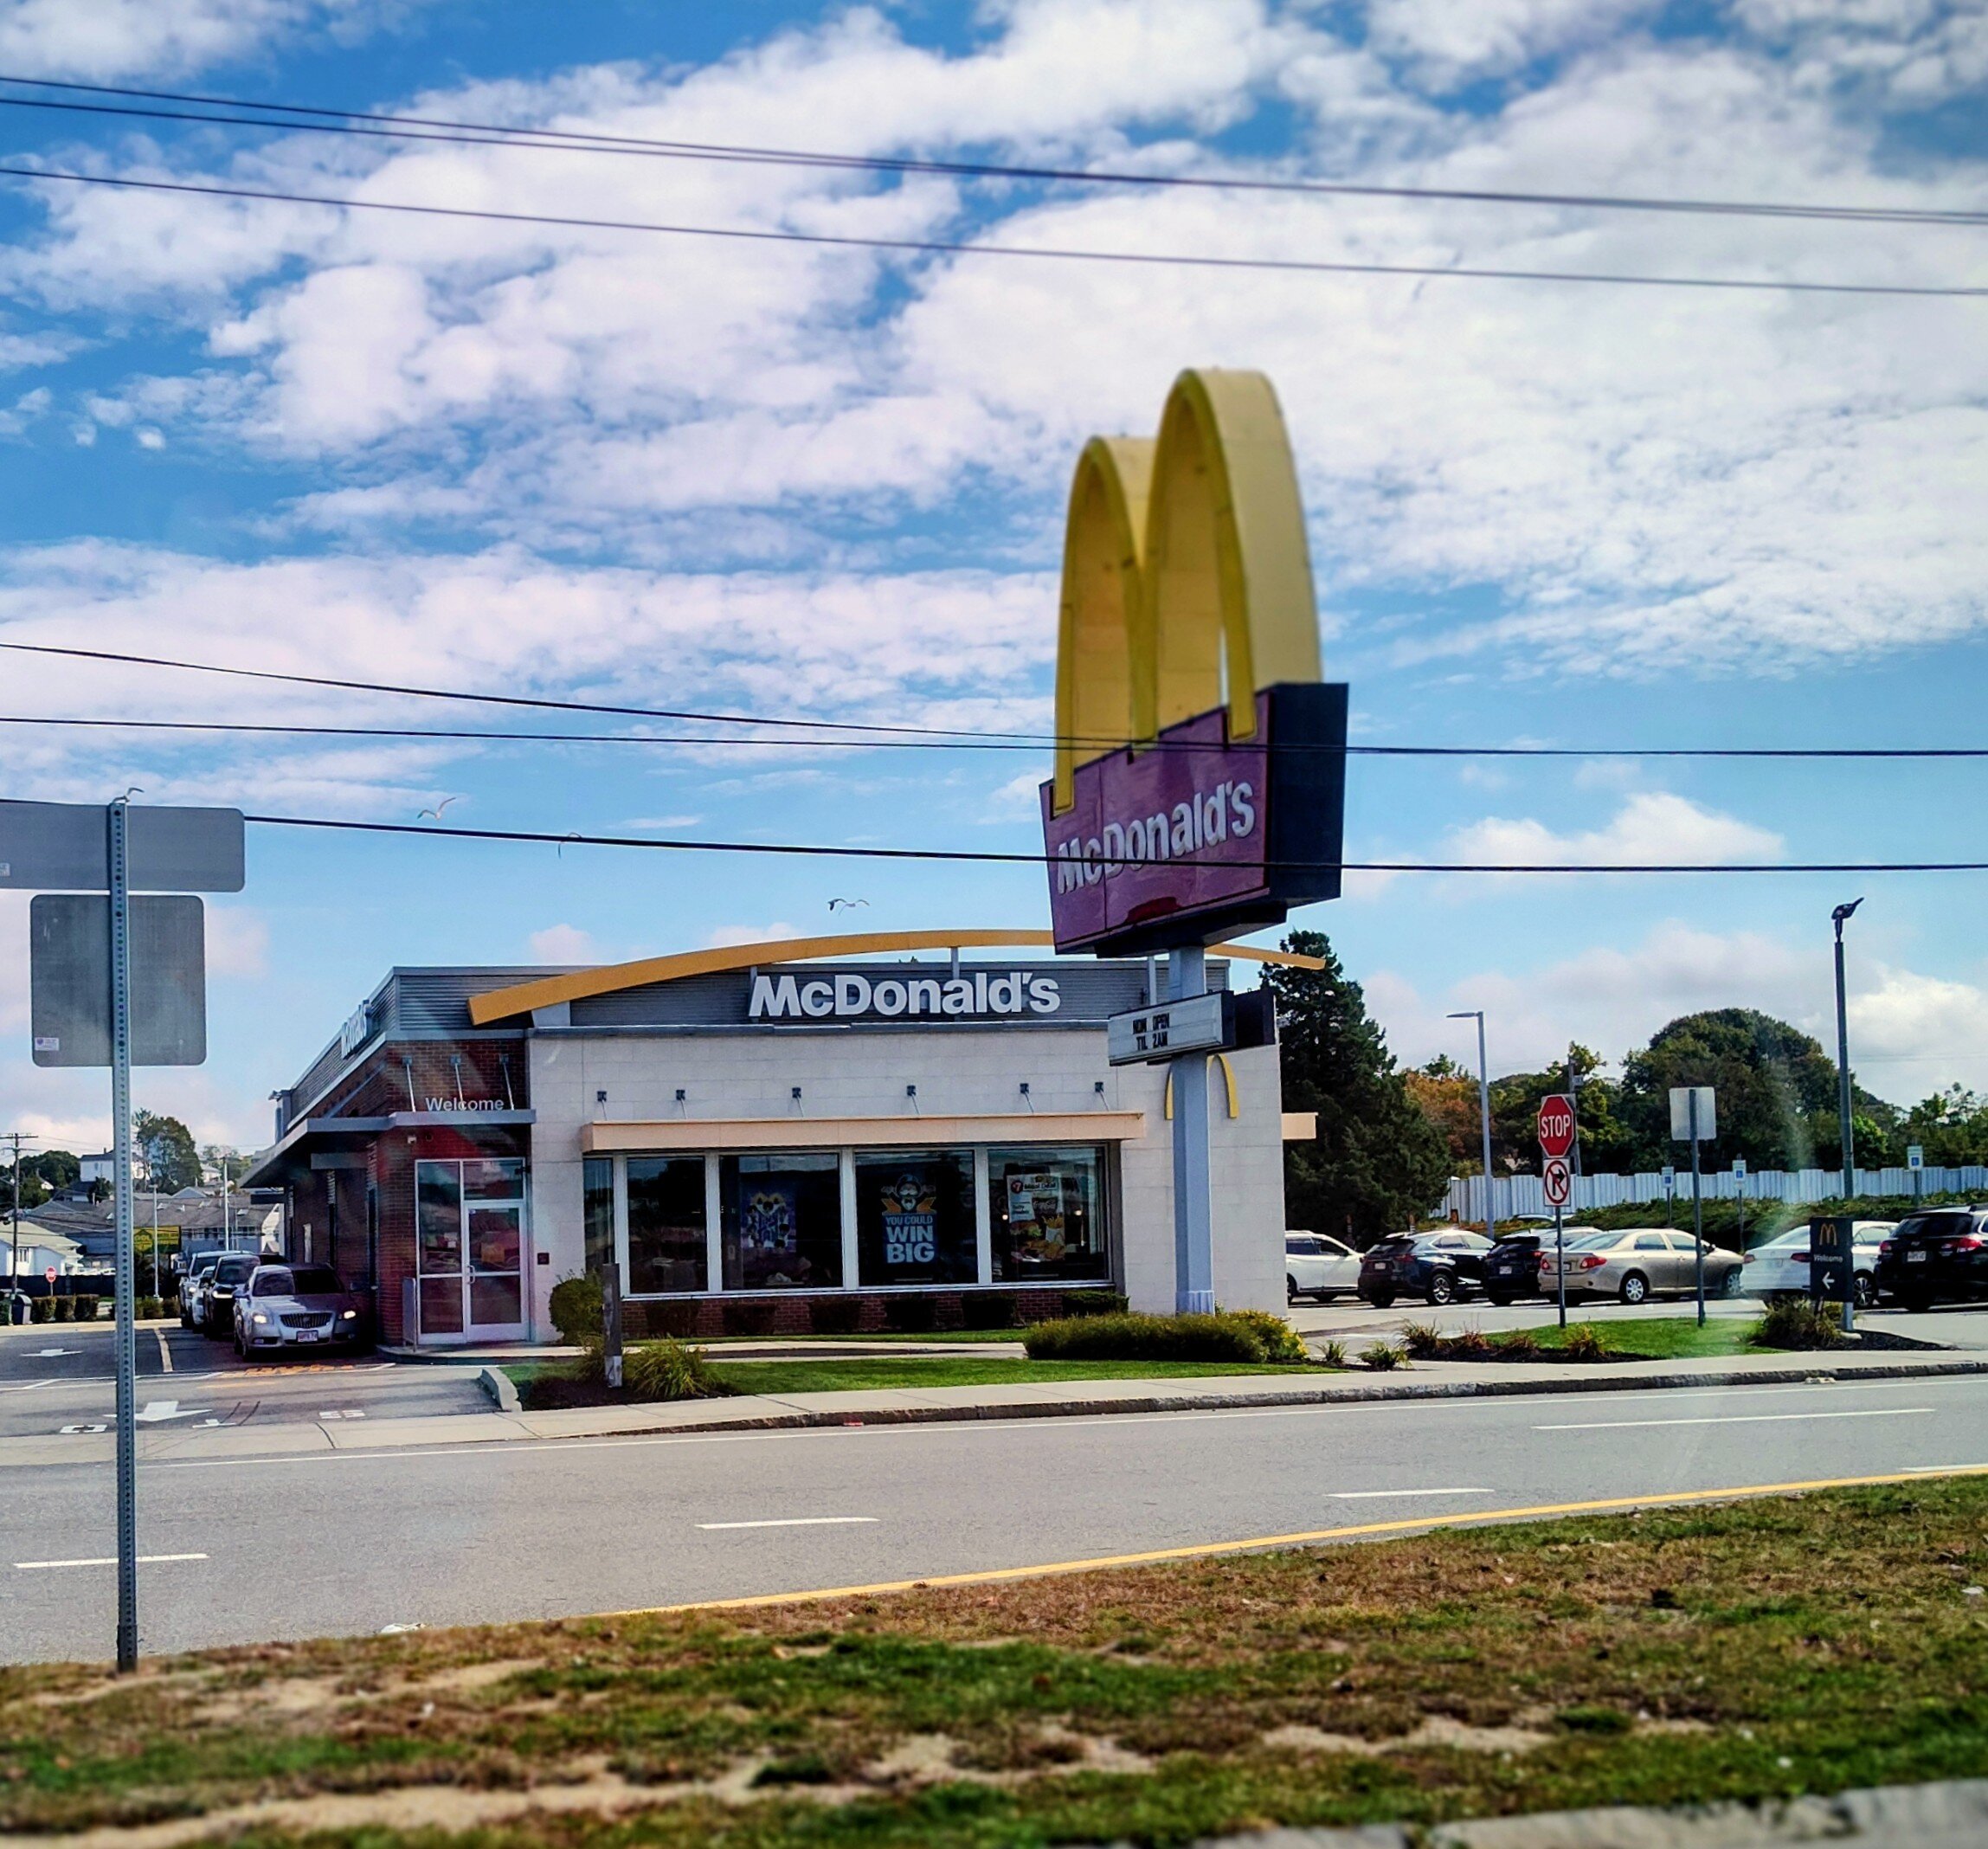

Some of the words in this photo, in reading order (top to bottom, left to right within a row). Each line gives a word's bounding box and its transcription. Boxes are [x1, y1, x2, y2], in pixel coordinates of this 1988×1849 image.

[1058, 781, 1255, 894] McDonald's
[749, 972, 1061, 1017] McDonald's
[425, 1097, 505, 1111] Welcome
[1541, 1114, 1571, 1138] STOP
[885, 1216, 903, 1226] YOU
[904, 1214, 934, 1225] COULD
[885, 1225, 934, 1243] WIN
[886, 1242, 935, 1264] BIG
